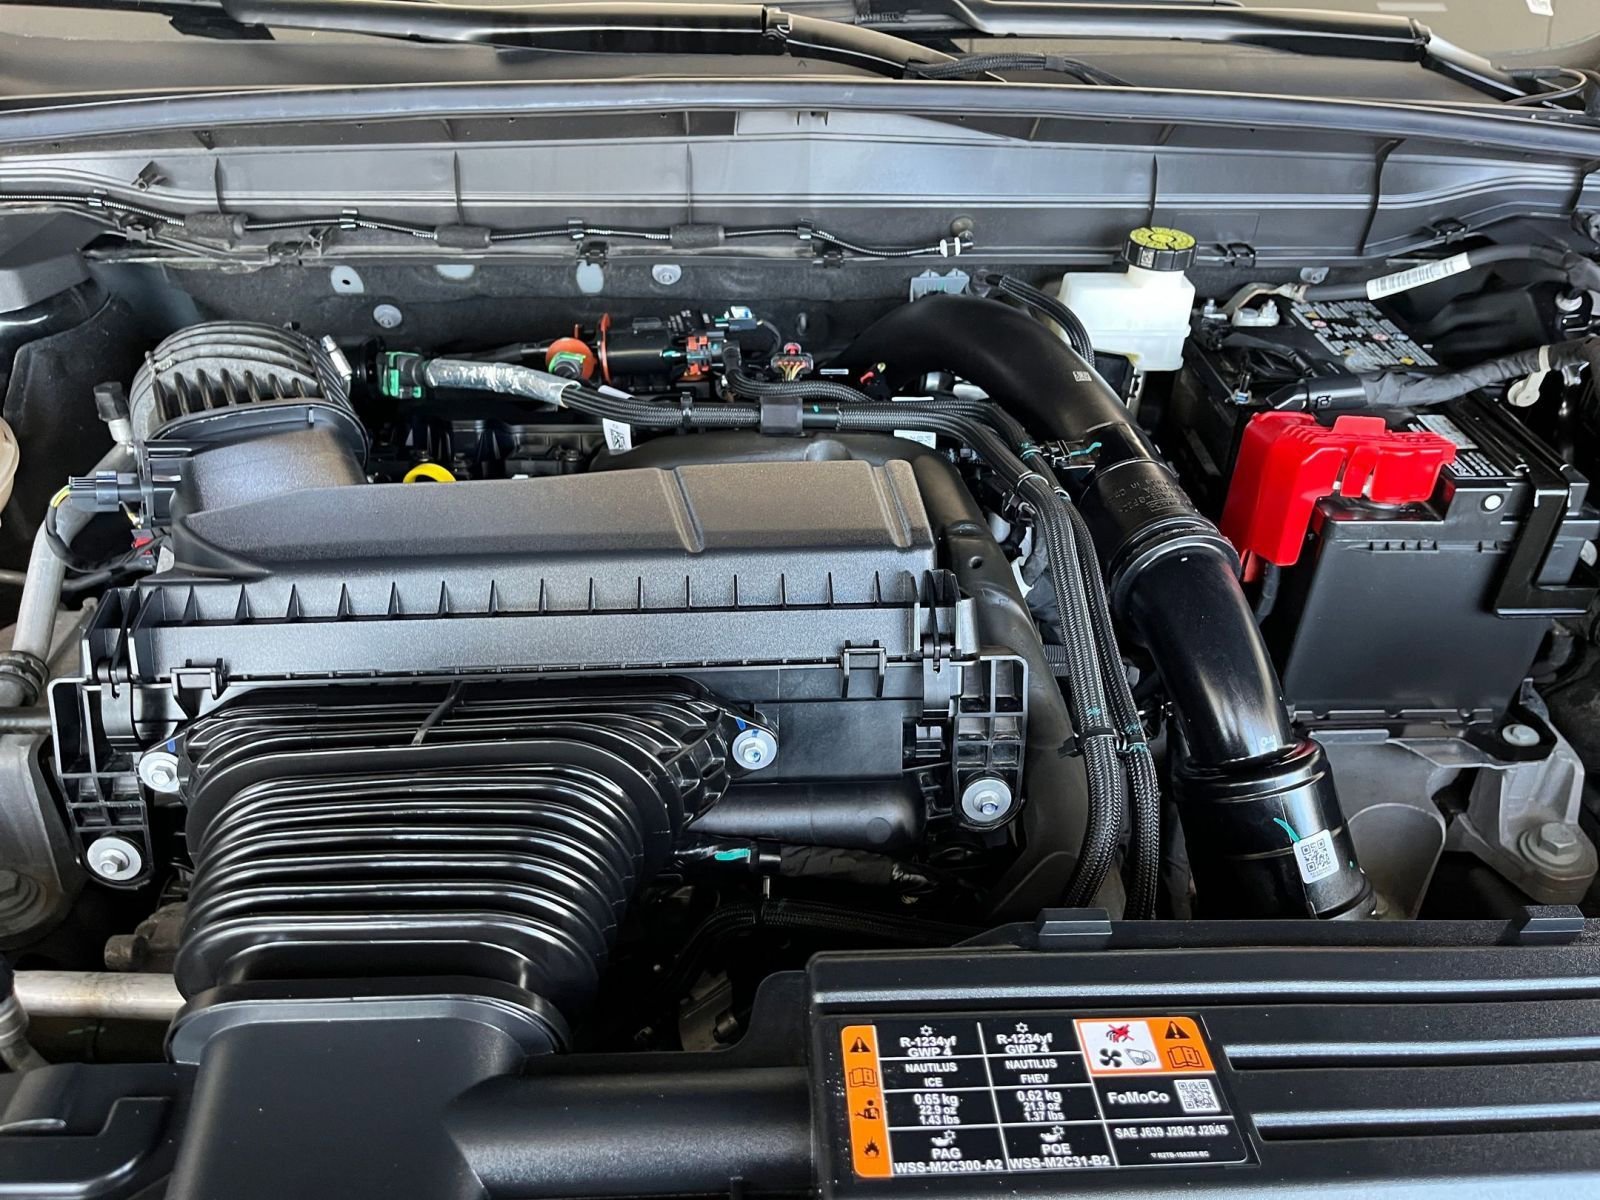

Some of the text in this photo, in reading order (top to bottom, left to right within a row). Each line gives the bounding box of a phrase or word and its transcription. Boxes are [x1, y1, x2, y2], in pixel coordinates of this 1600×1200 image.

[899, 1035, 957, 1048] R-1234yf
[996, 1032, 1053, 1045] R-1234yf
[907, 1046, 953, 1057] GWP 4
[1005, 1043, 1050, 1054] GWP 4
[905, 1062, 958, 1073] NAUTILUS
[1005, 1058, 1058, 1070] NAUTILUS
[924, 1077, 944, 1088] ICE
[1020, 1073, 1049, 1084] FHEV
[913, 1093, 959, 1107] 0.65 kg
[1016, 1089, 1063, 1104] 0.62 kg
[1106, 1090, 1170, 1105] FoMoCo
[919, 1105, 957, 1115] 22.9 oz
[1023, 1101, 1061, 1112] 21.9 oz
[919, 1114, 961, 1125] 1.43 lbs
[1024, 1110, 1066, 1122] 1.37 lbs
[1114, 1123, 1229, 1140] SAE J639 J2842 J2845
[931, 1147, 963, 1160] PAG
[1041, 1142, 1072, 1156] POE
[894, 1158, 1004, 1174] WSS-M2C300-A2
[1008, 1154, 1111, 1169] WSS-M2C31-B2
